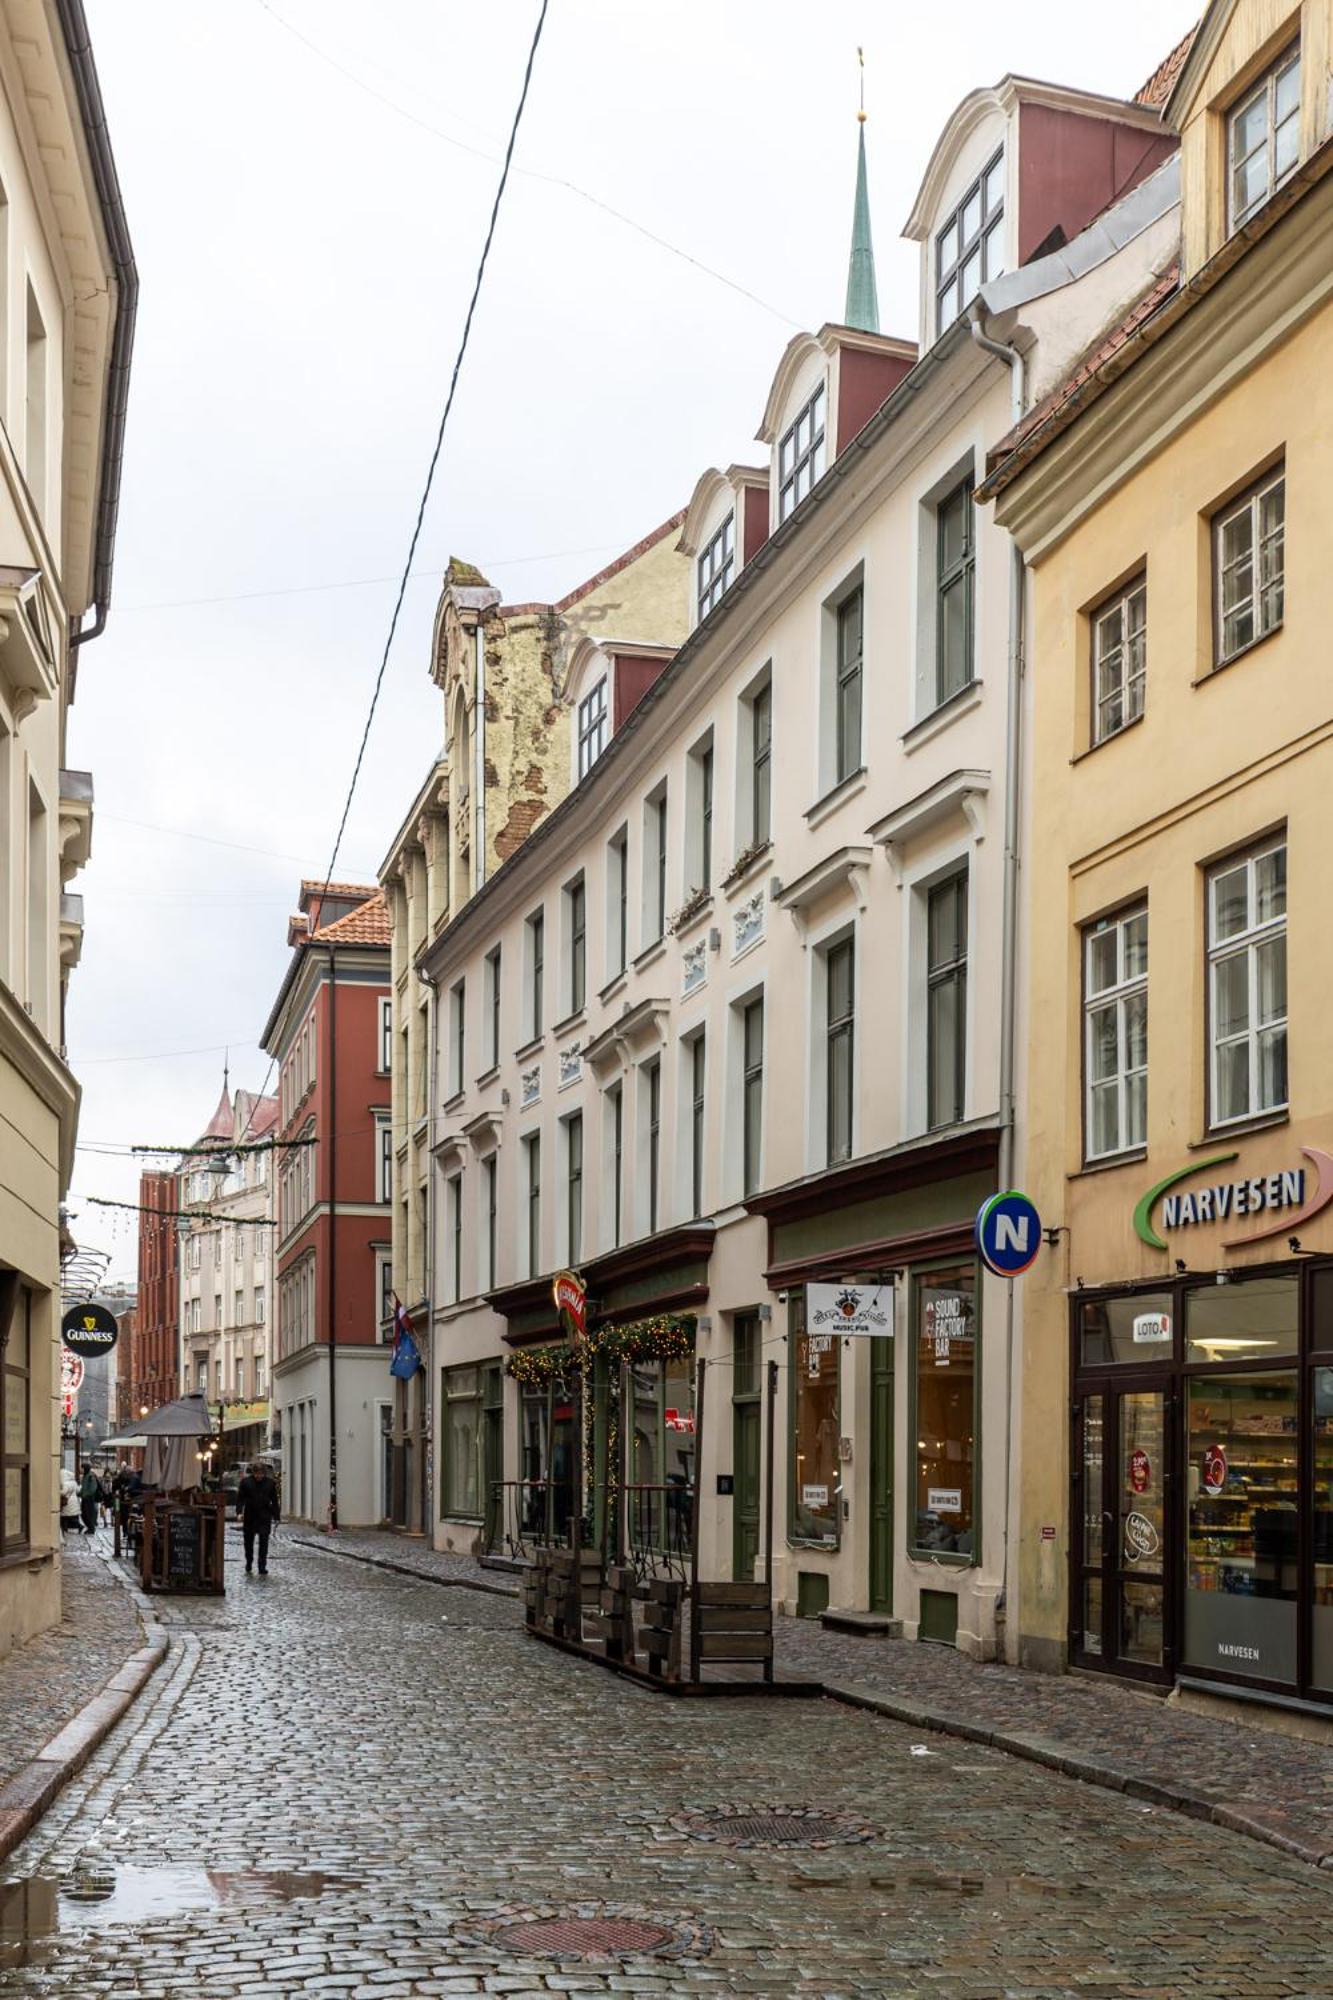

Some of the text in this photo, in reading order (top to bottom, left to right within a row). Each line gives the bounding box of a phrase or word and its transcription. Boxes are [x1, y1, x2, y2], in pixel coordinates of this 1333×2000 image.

[1163, 1168, 1305, 1228] NARVESEN
[995, 1213, 1029, 1252] N
[935, 1296, 960, 1318] SOUND
[67, 1329, 113, 1342] GUINNESS
[935, 1316, 966, 1337] FACTORY
[935, 1338, 949, 1357] BAR
[1218, 1642, 1259, 1661] NARVESEN
